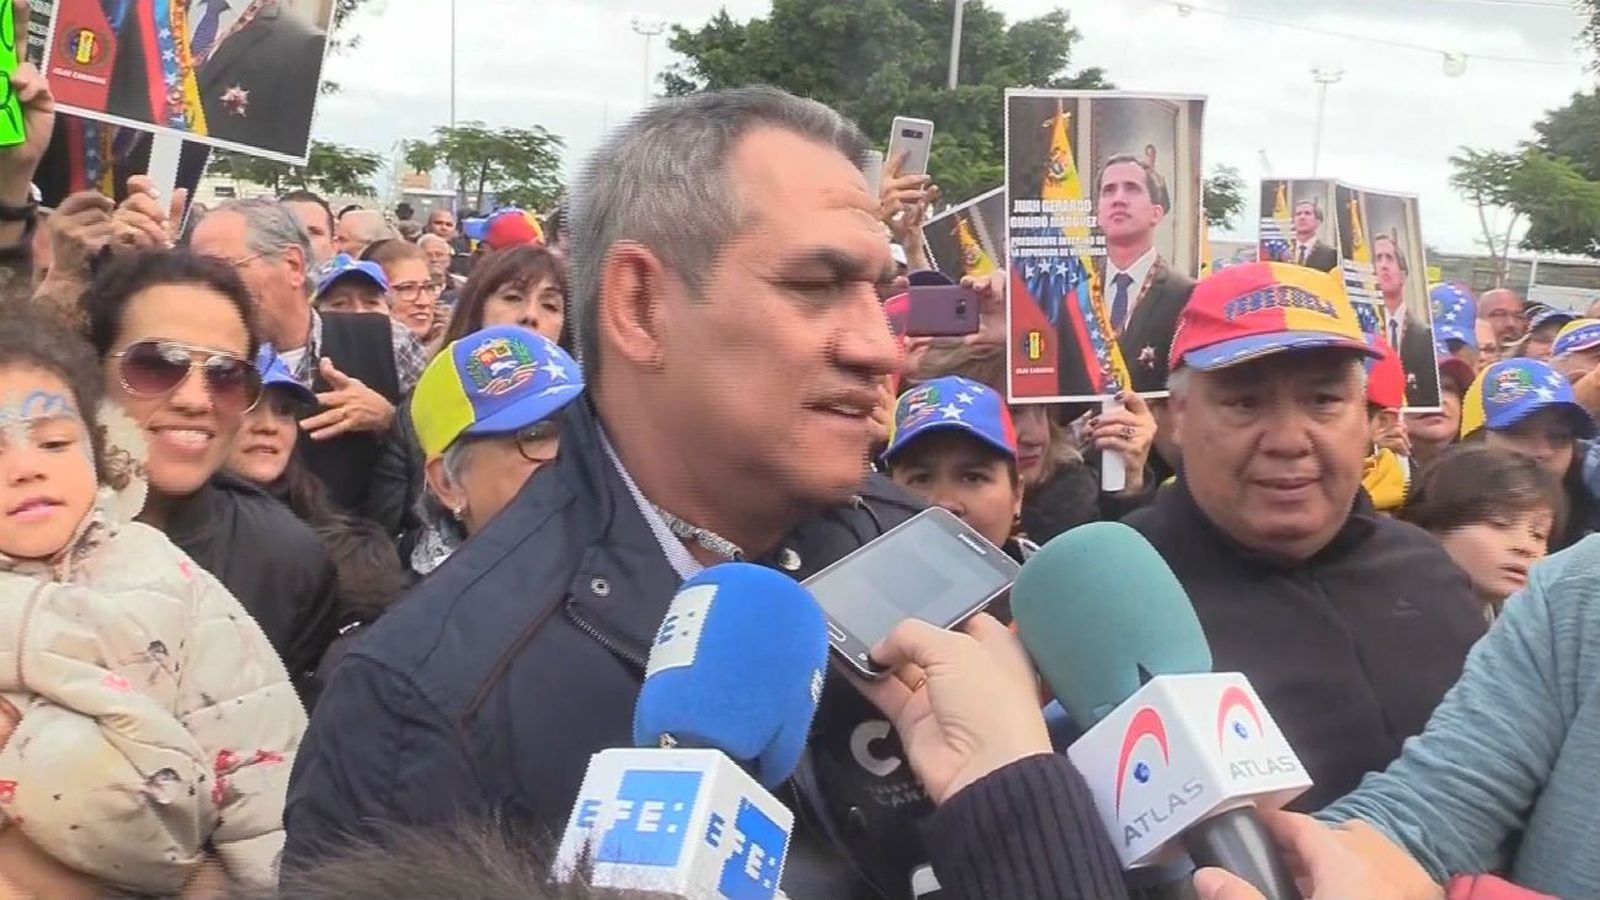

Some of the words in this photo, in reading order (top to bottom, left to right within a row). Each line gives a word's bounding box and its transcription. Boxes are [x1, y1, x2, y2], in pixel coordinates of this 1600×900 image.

[1013, 199, 1041, 213] JUAN
[1229, 755, 1297, 781] ATLAS
[1122, 777, 1205, 848] ATLAS
